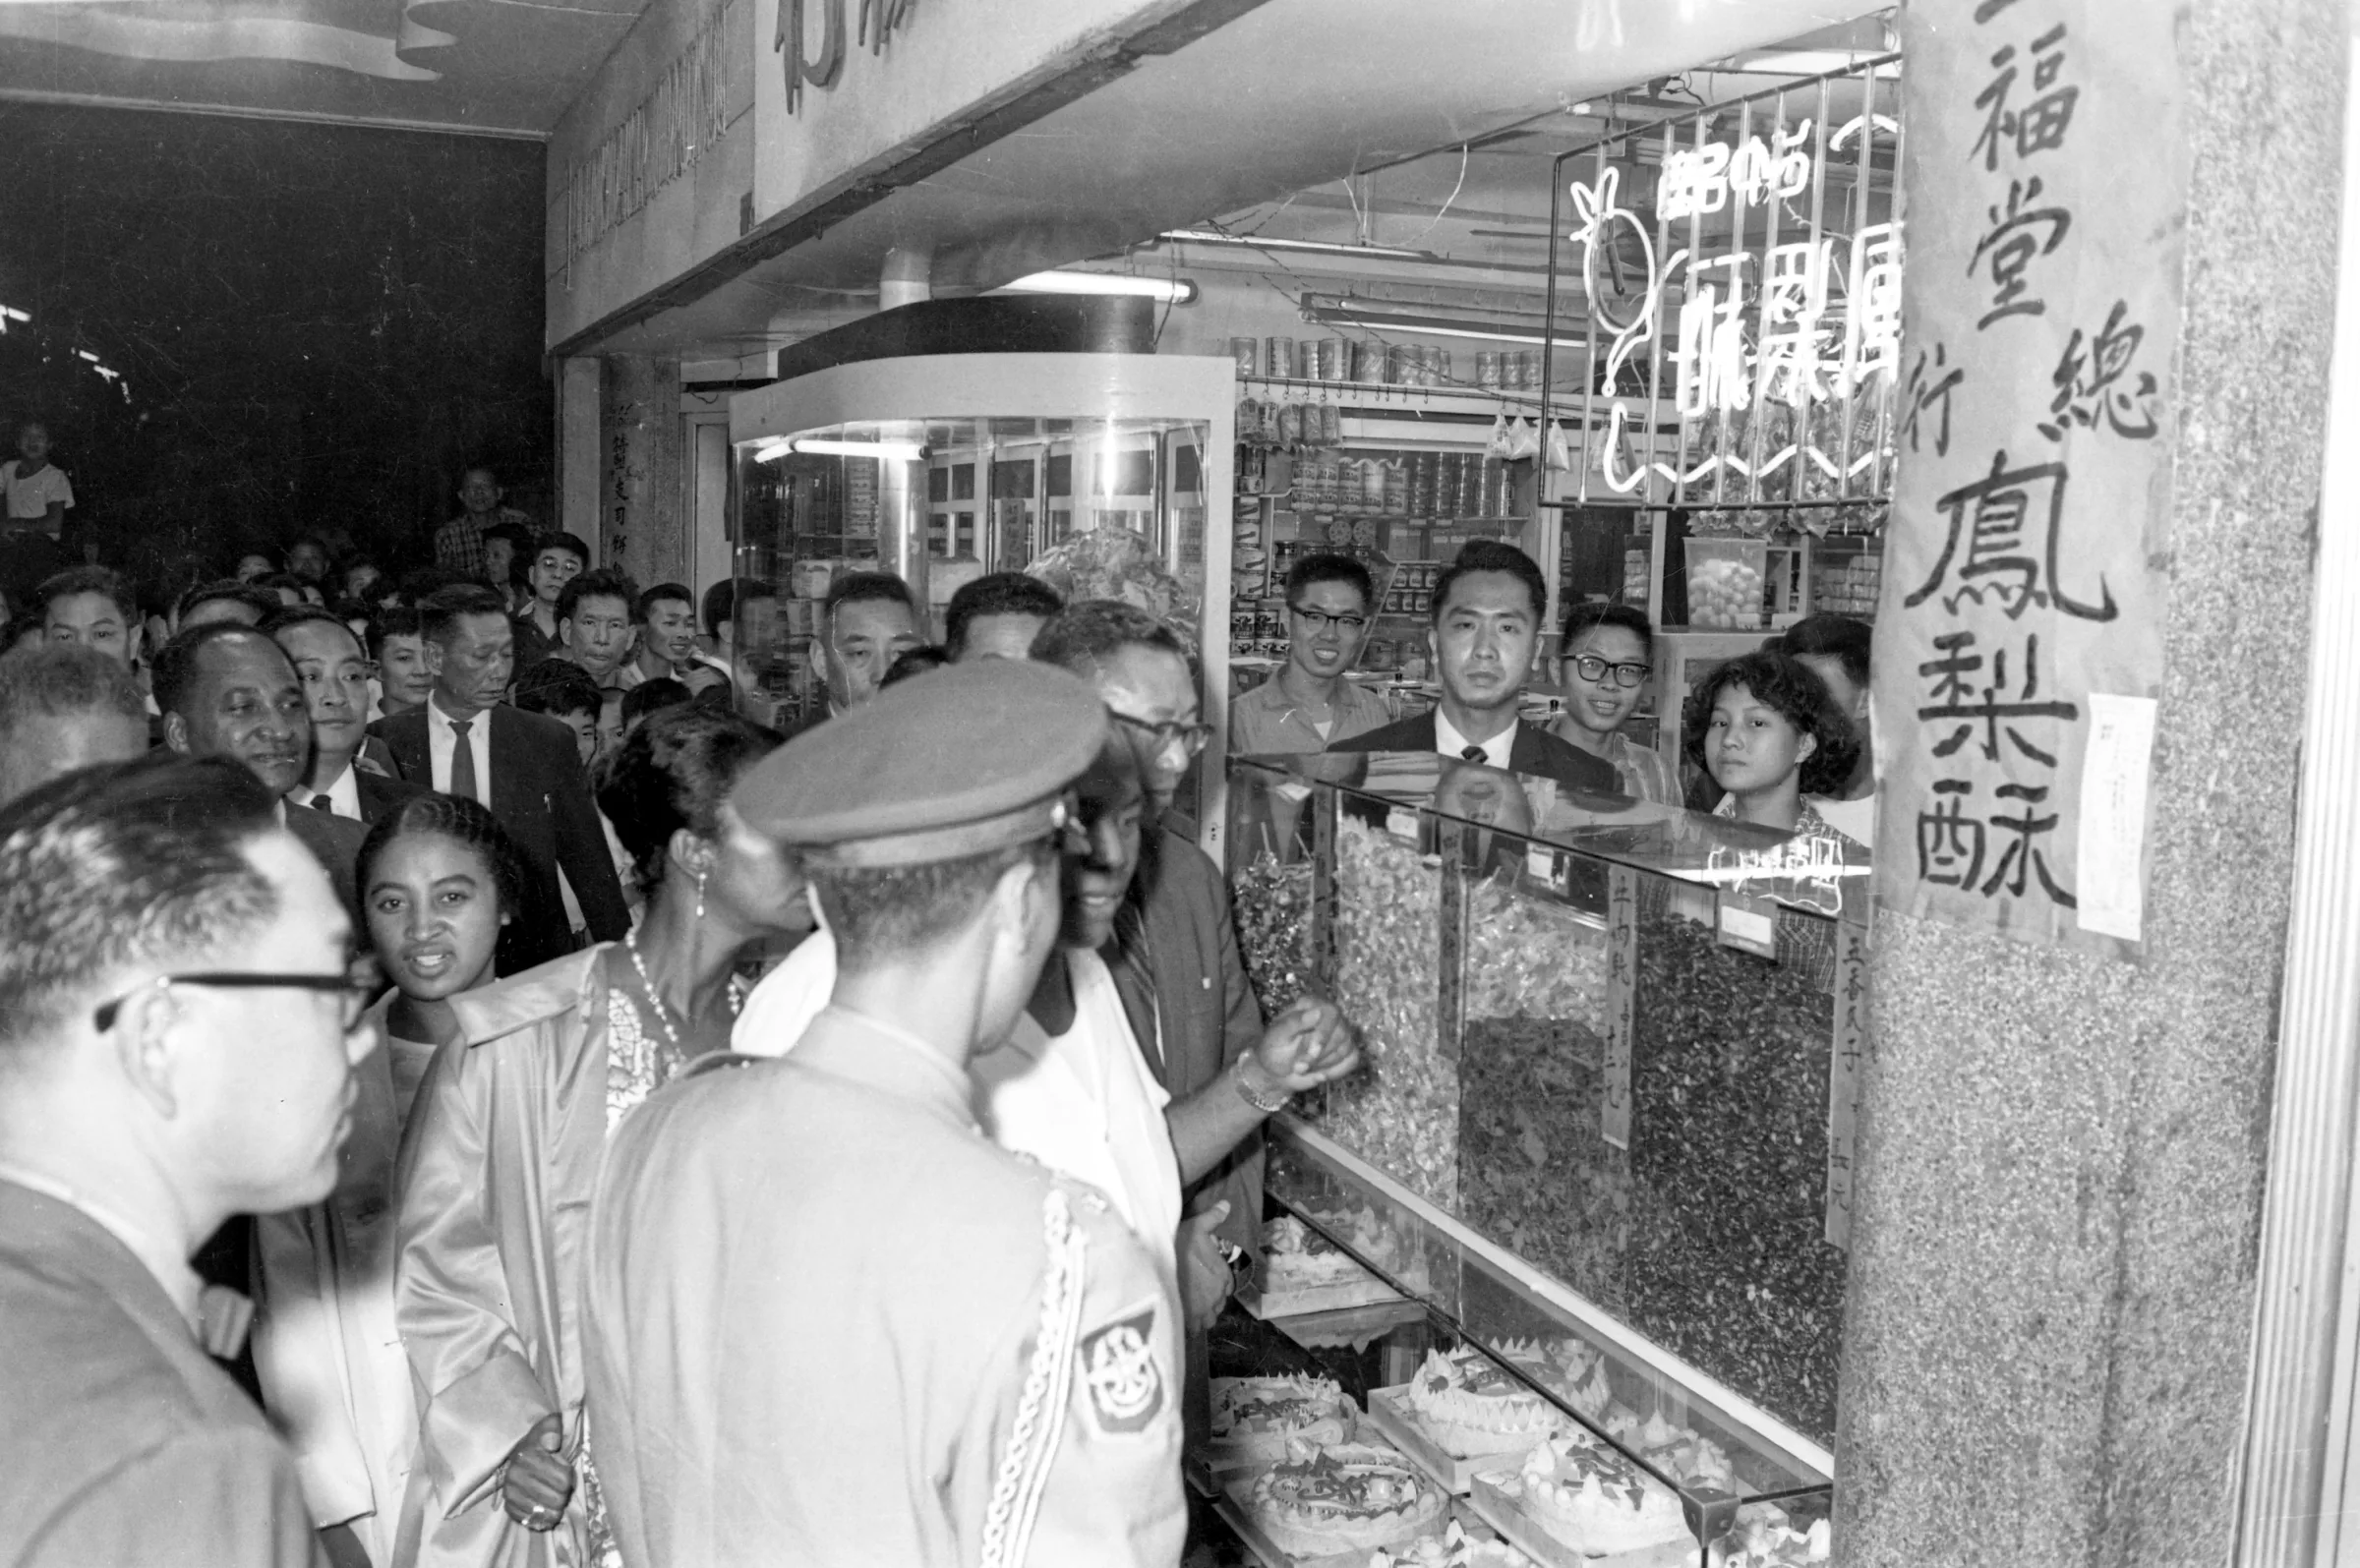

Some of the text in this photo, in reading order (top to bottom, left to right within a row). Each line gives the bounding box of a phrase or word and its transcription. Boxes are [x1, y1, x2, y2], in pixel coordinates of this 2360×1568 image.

[1966, 0, 2080, 331] 福堂
[1904, 449, 2119, 909] 鳳梨酥
